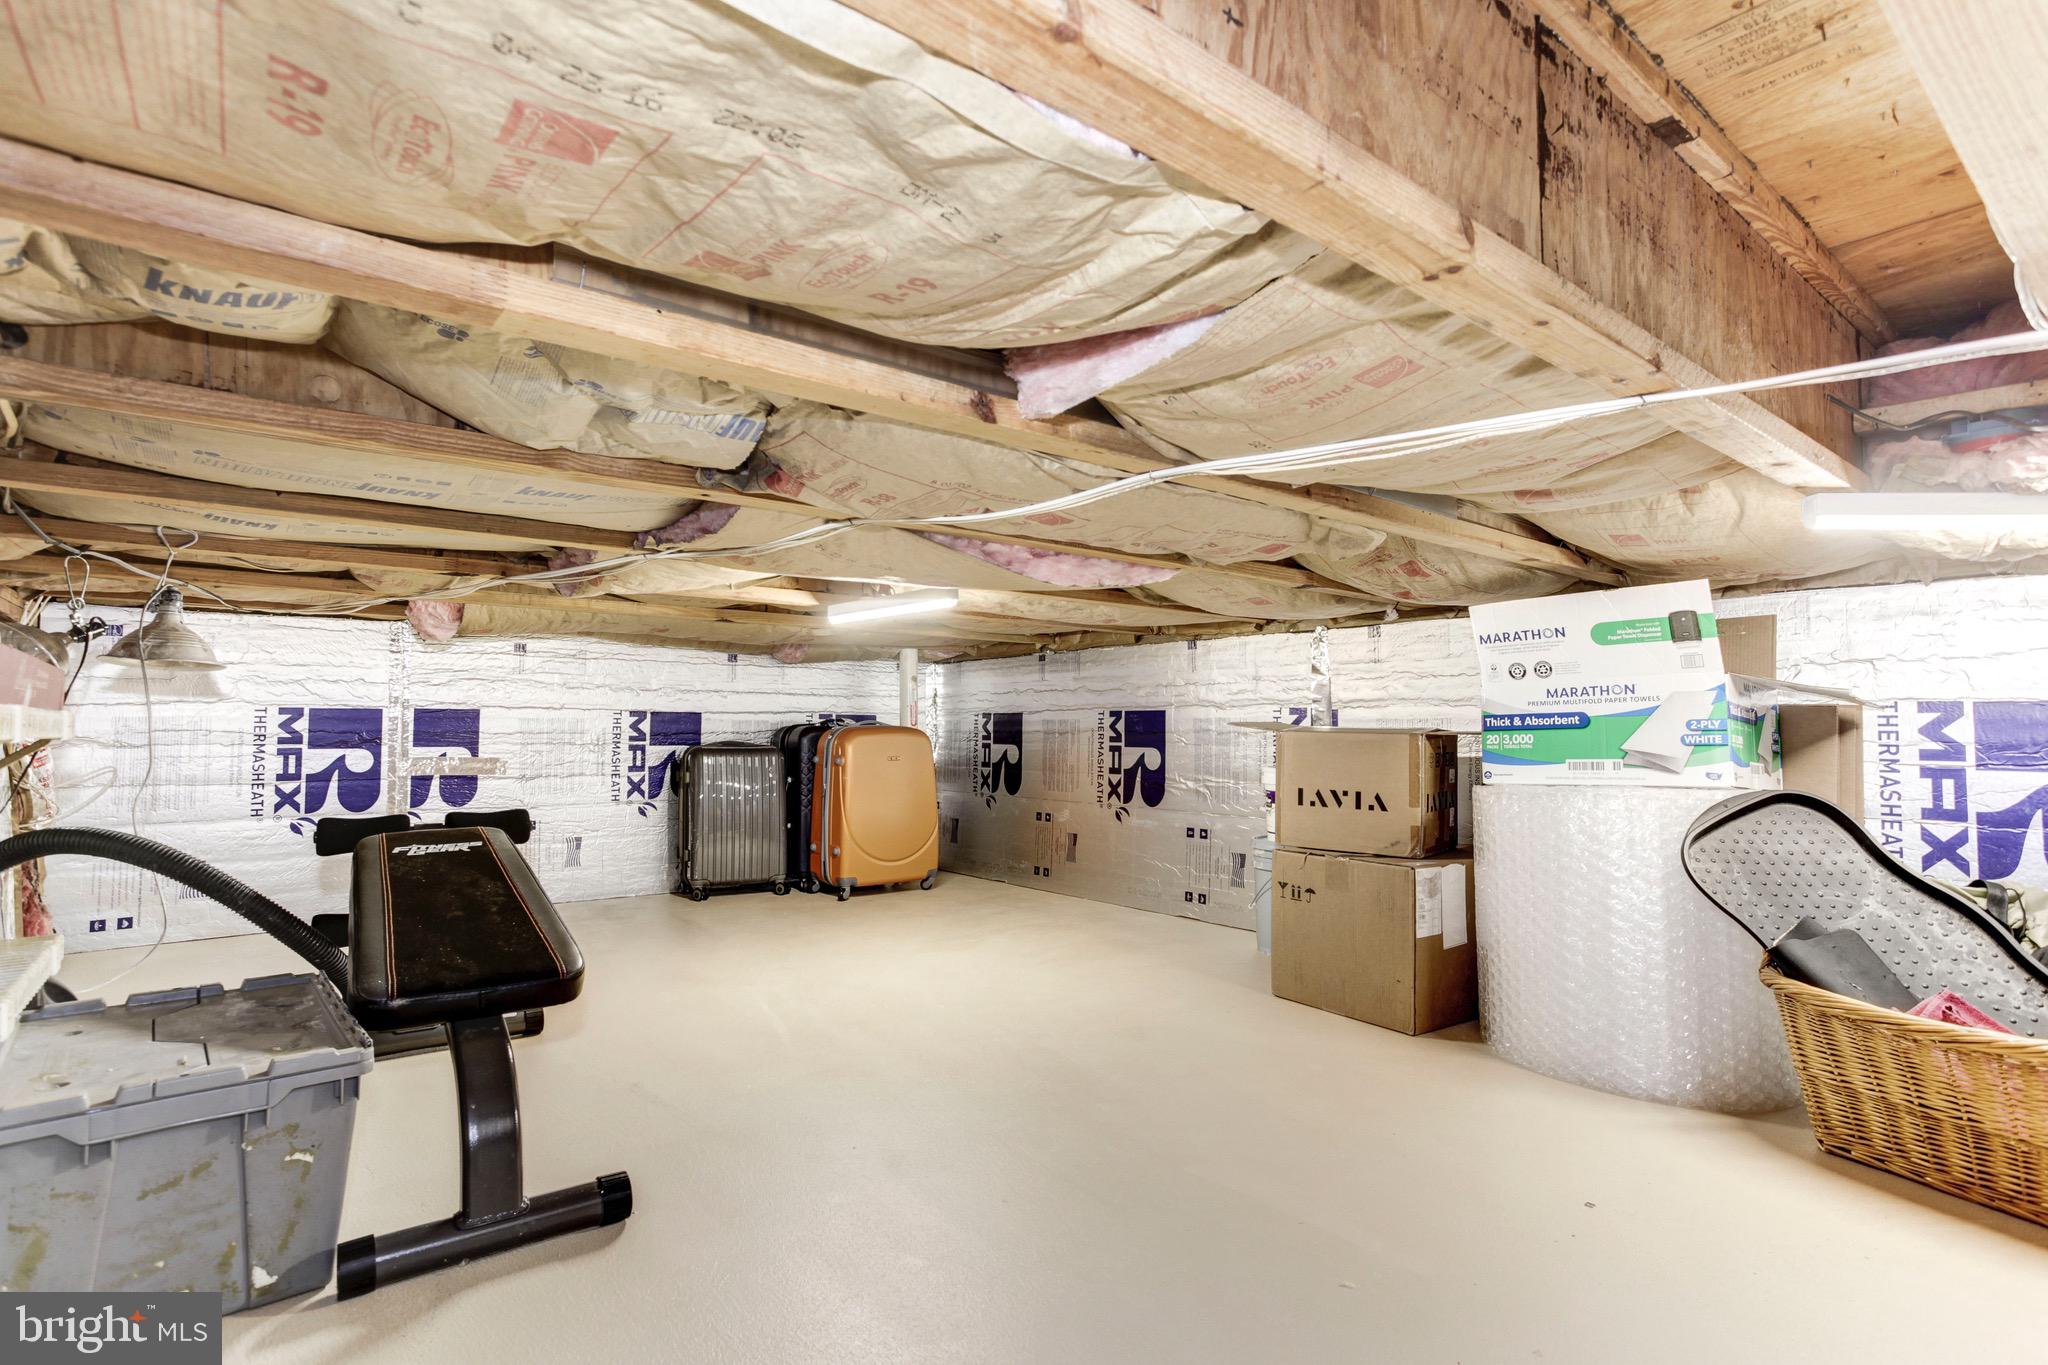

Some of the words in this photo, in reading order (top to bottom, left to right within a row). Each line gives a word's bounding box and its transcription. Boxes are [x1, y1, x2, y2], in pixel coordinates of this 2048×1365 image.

[265, 53, 329, 137] R-19
[868, 276, 938, 305] R-19
[1479, 626, 1566, 645] MARATHON
[1485, 716, 1513, 728] Thick
[1513, 716, 1522, 727] &
[1524, 715, 1580, 727] Absorbent
[1527, 698, 1558, 708] PREMIUM
[1560, 697, 1603, 706] MULTIFOLD
[1604, 696, 1628, 704] PAPER
[1629, 695, 1661, 703] TOWELS
[1545, 683, 1636, 699] MARATHON
[1690, 720, 1721, 729] 2-PLY
[250, 706, 268, 818] THERMASHEATH
[273, 707, 305, 815] MAX
[610, 709, 623, 803] THERMASHEATH
[626, 710, 648, 801] MAX
[980, 712, 993, 794] MAX
[1096, 709, 1105, 804] THERMASHEATH
[1107, 710, 1123, 804] MAX
[1486, 734, 1500, 745] 20
[1502, 734, 1534, 745] 3,000
[1683, 735, 1723, 744] WHITE
[1876, 700, 1904, 861] THERMASHEAT
[1917, 701, 1971, 879] MAX
